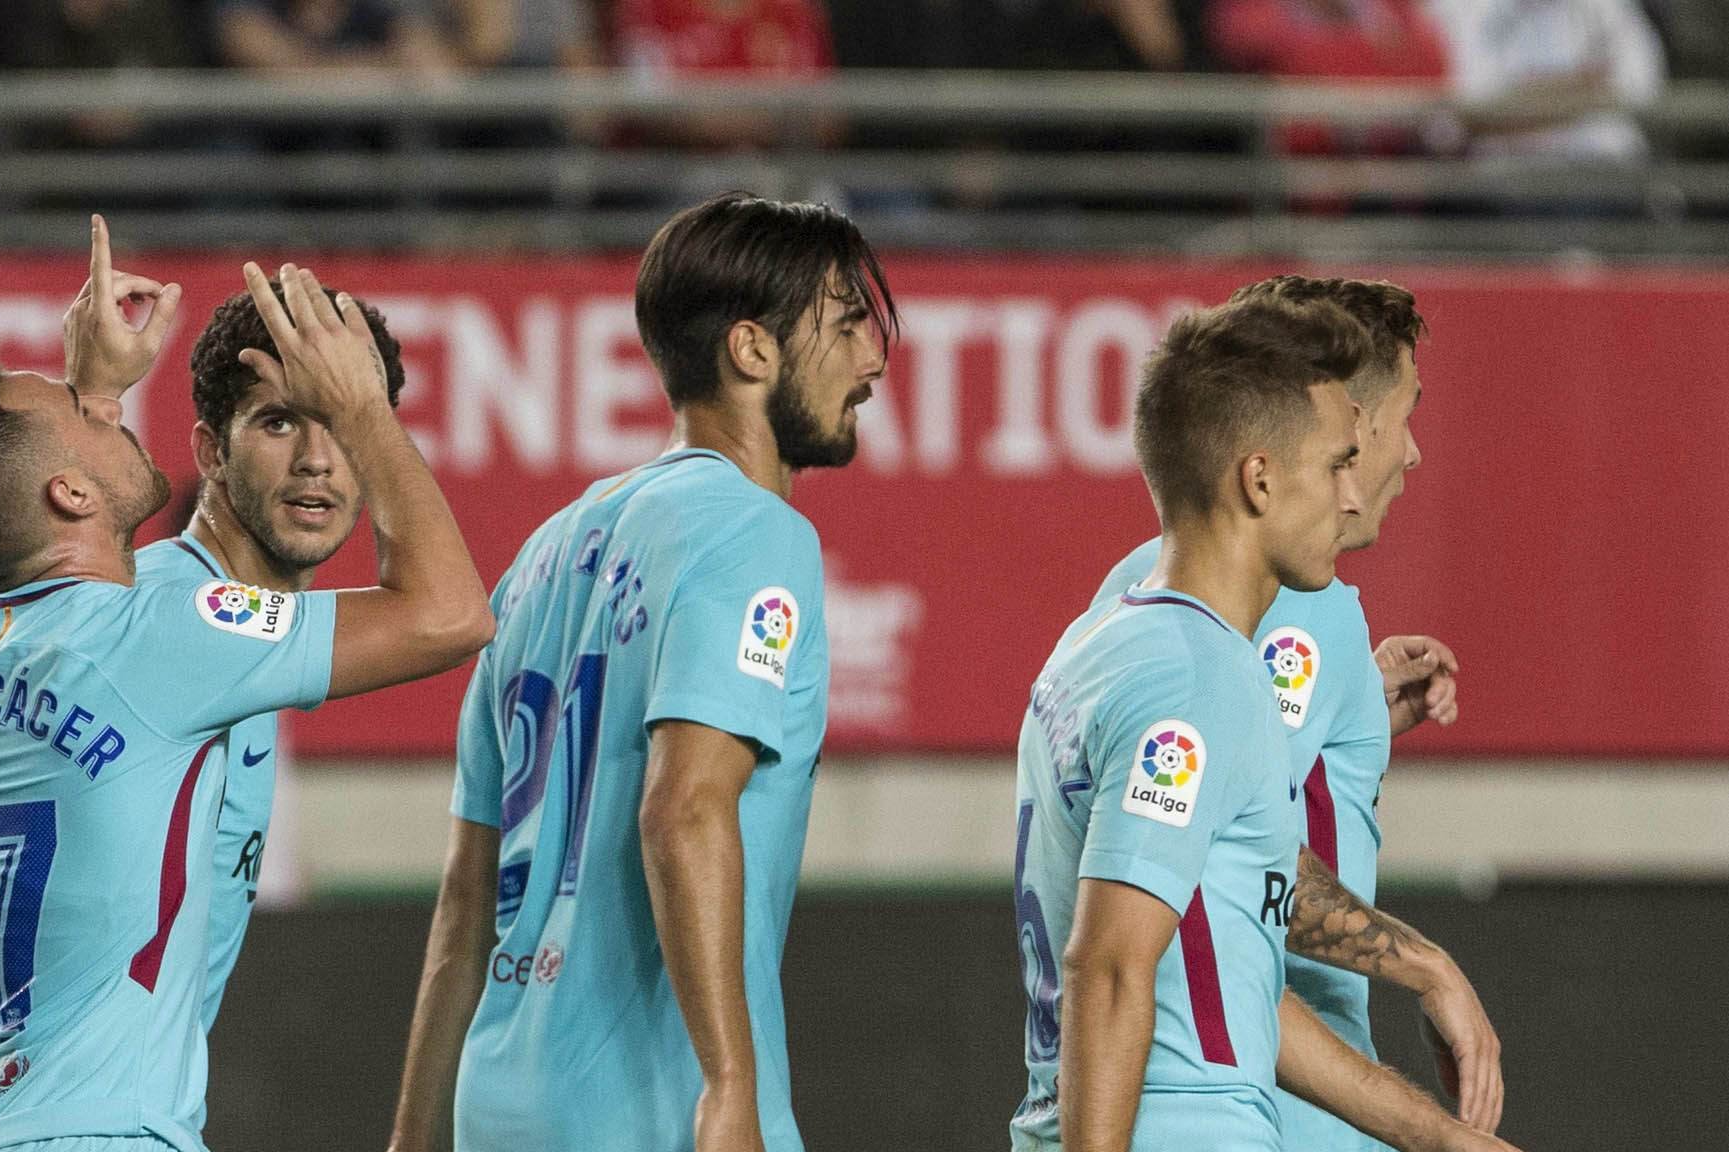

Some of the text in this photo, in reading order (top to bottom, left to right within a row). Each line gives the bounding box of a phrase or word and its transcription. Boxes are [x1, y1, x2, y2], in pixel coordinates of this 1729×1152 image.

[263, 593, 285, 634] LaLig
[1277, 692, 1302, 715] iga
[496, 654, 607, 922] 21
[1131, 786, 1188, 814] LaLiga
[232, 830, 265, 883] R
